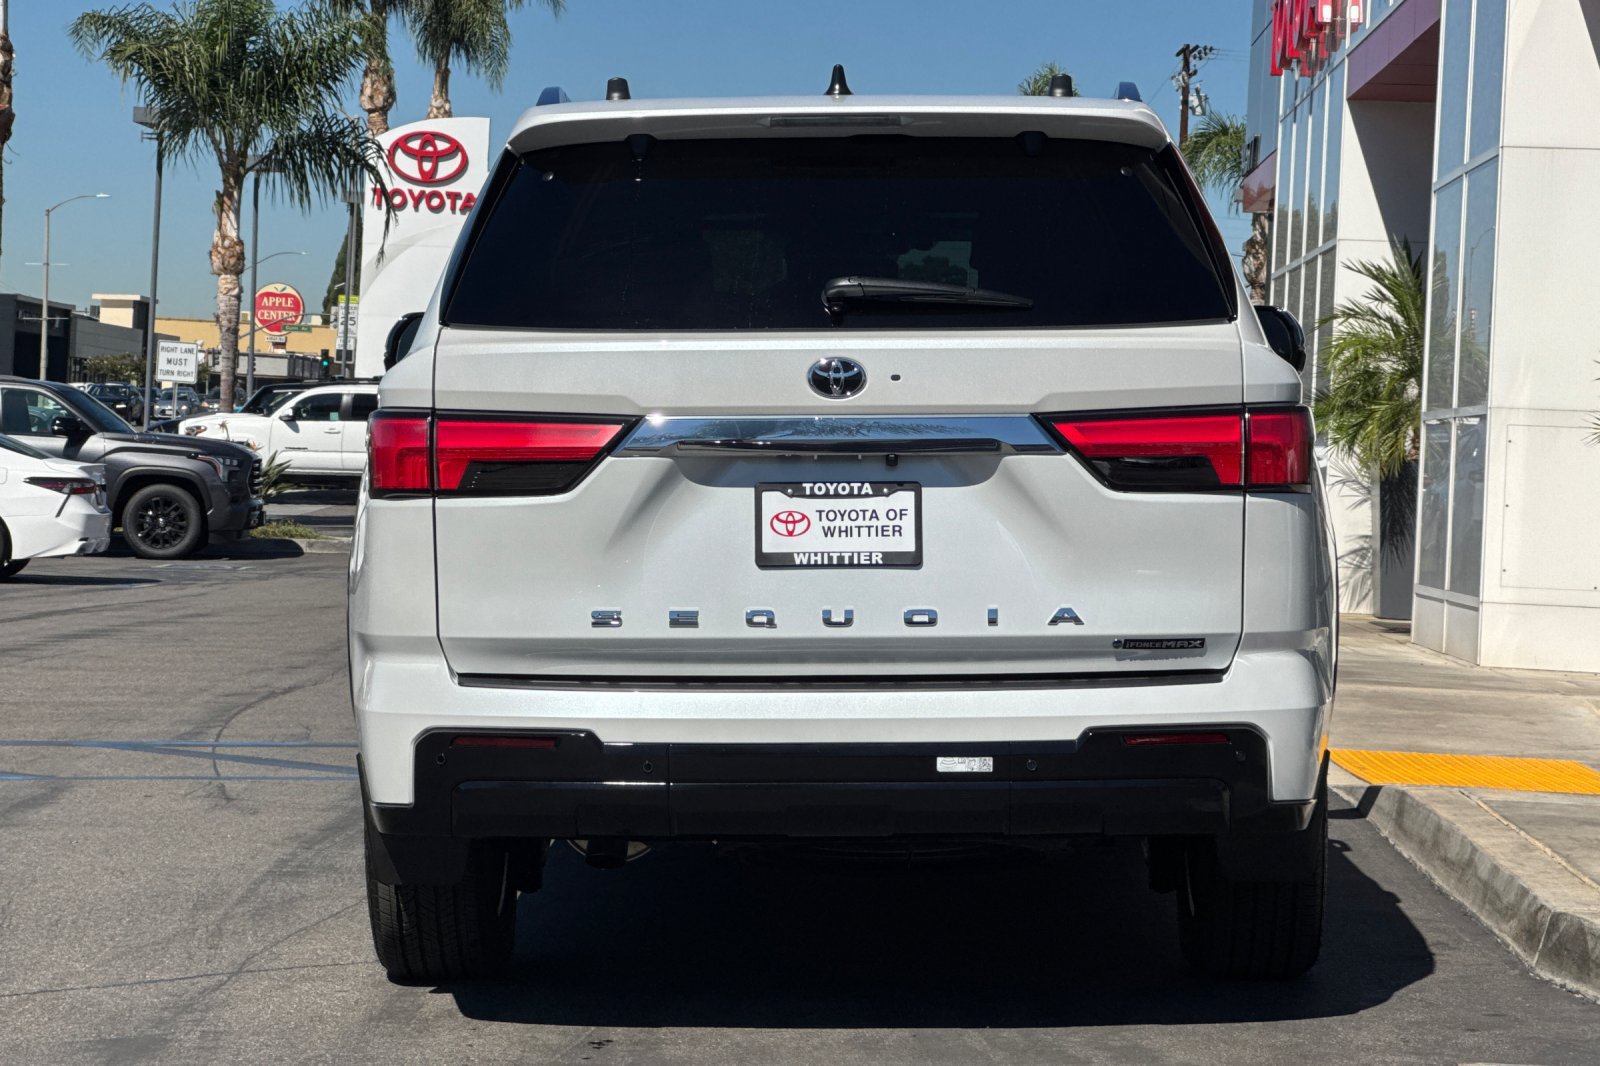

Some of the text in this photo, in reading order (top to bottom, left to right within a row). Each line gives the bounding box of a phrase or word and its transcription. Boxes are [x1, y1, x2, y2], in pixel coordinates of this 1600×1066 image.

[371, 187, 477, 213] TOYOTA
[261, 296, 295, 308] APPLE
[257, 309, 296, 321] CENTER
[160, 345, 196, 355] RIGHT LANE
[166, 357, 188, 366] MUST
[159, 368, 194, 378] TURN RIGHT
[802, 482, 874, 496] TOYOTA
[815, 508, 909, 522] TOYOTA OF
[822, 524, 903, 538] WHITTIER
[793, 552, 884, 565] WHITTIER
[590, 606, 1085, 629] SEQUOIA
